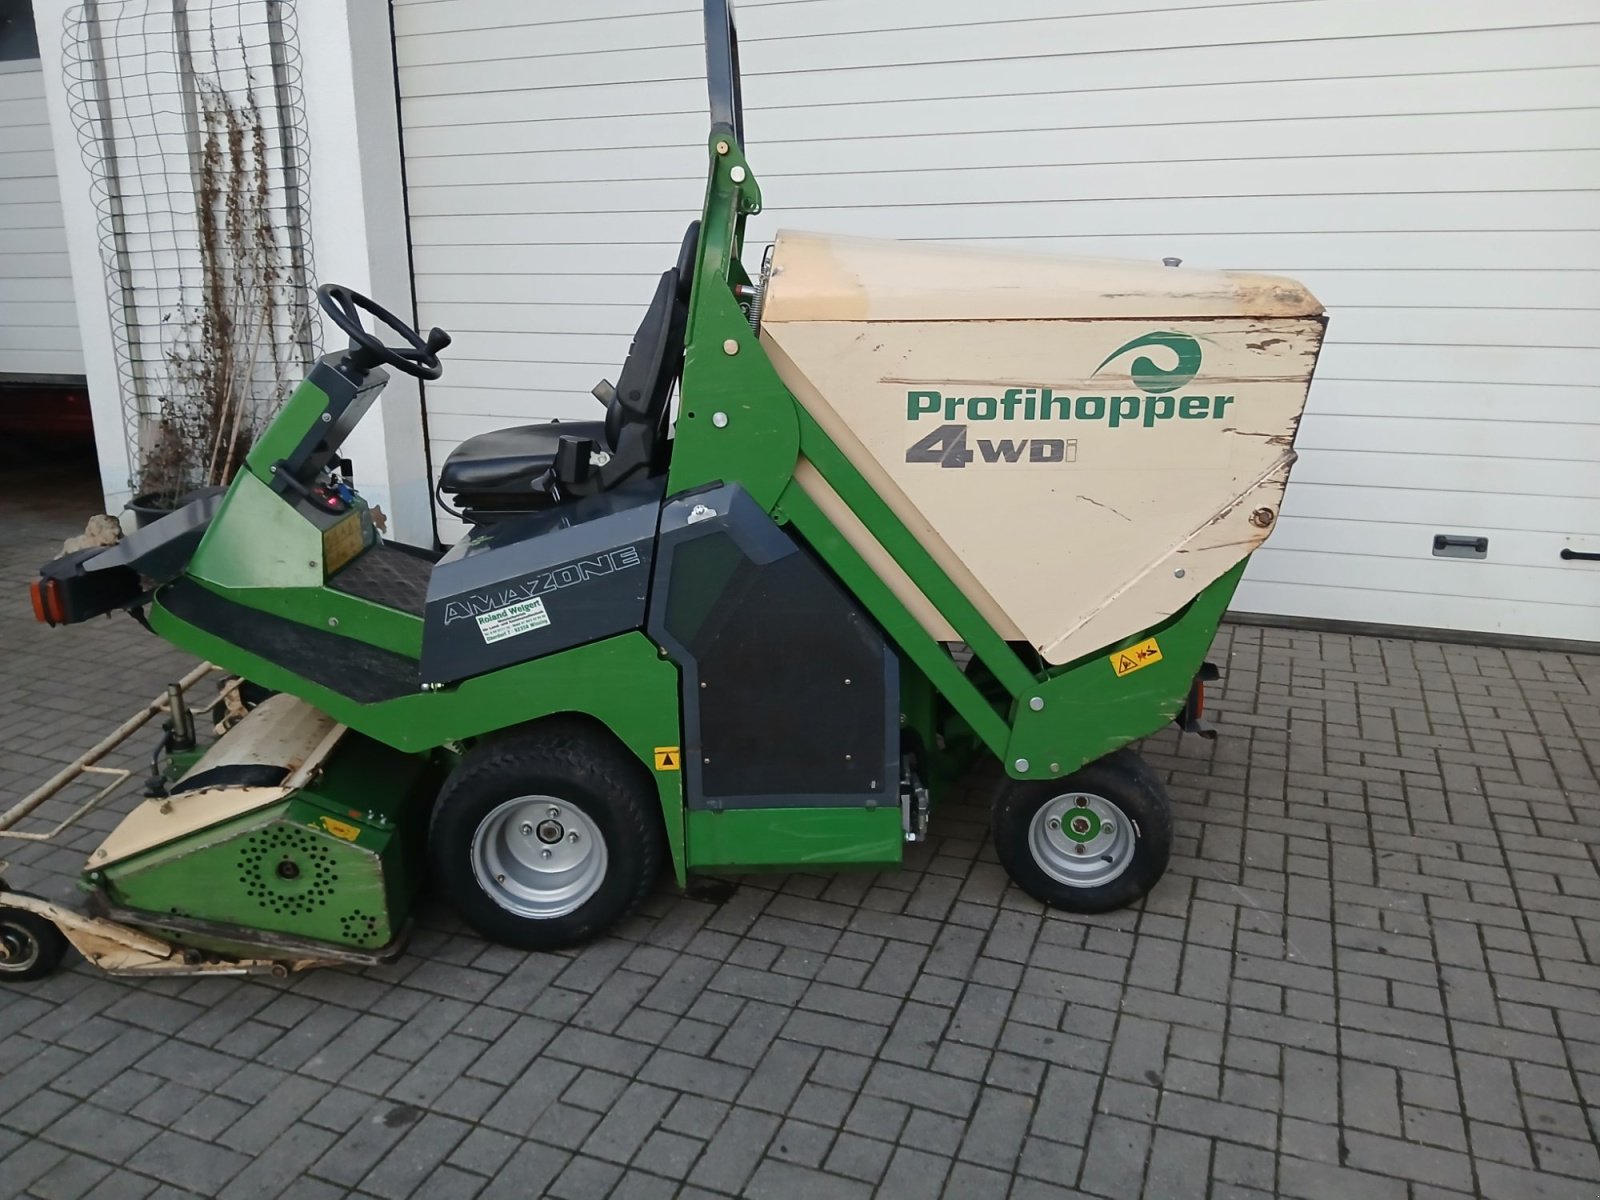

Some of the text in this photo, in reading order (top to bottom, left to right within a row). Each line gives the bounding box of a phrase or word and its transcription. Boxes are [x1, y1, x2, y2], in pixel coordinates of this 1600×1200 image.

[907, 388, 1234, 427] Profihopper
[444, 546, 640, 625] AMAZONE
[478, 609, 507, 624] Roland
[508, 600, 541, 615] Weigert
